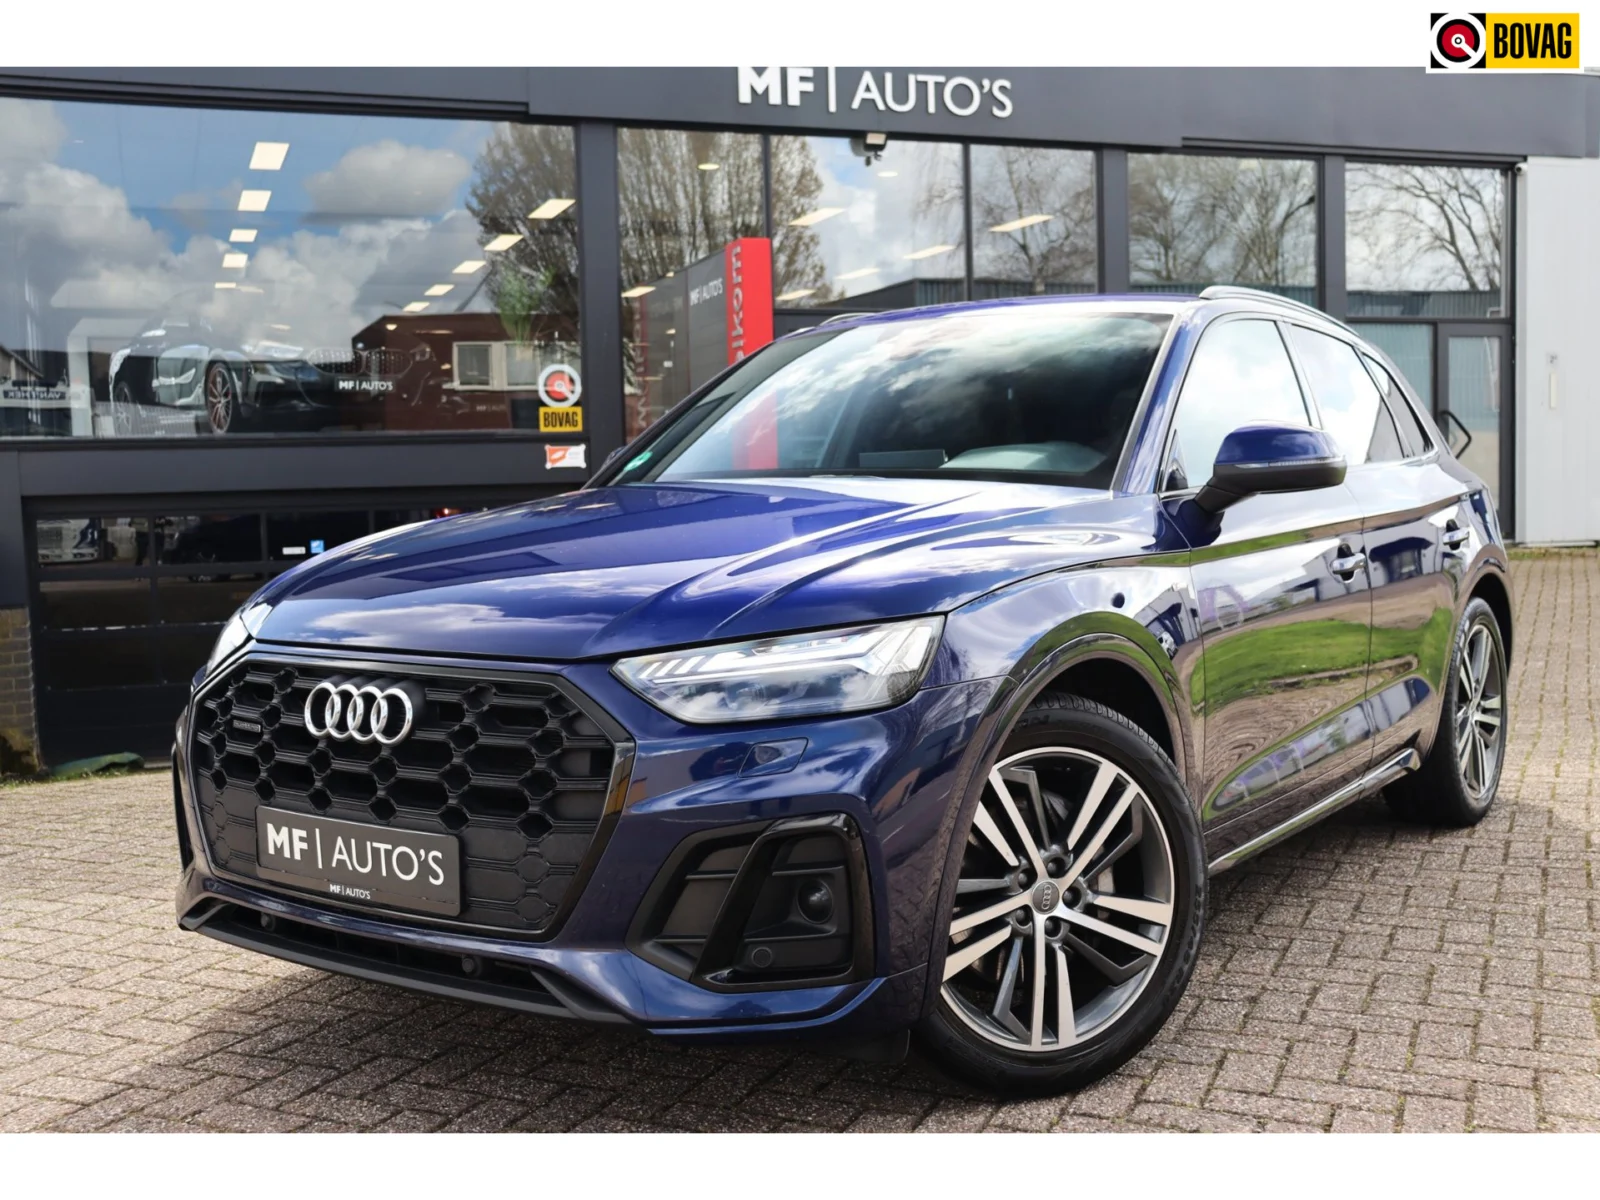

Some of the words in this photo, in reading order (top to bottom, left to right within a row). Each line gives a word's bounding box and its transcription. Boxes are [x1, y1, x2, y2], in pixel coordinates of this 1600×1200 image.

[737, 66, 814, 106] MF
[851, 70, 1013, 118] AUTO'S
[339, 380, 355, 390] MF
[361, 380, 393, 391] AUTO'S
[543, 411, 579, 428] BOVAG
[266, 823, 308, 861] MF
[331, 836, 445, 886] AUTO'S
[330, 884, 341, 893] MF
[346, 887, 370, 900] AUTO'S
